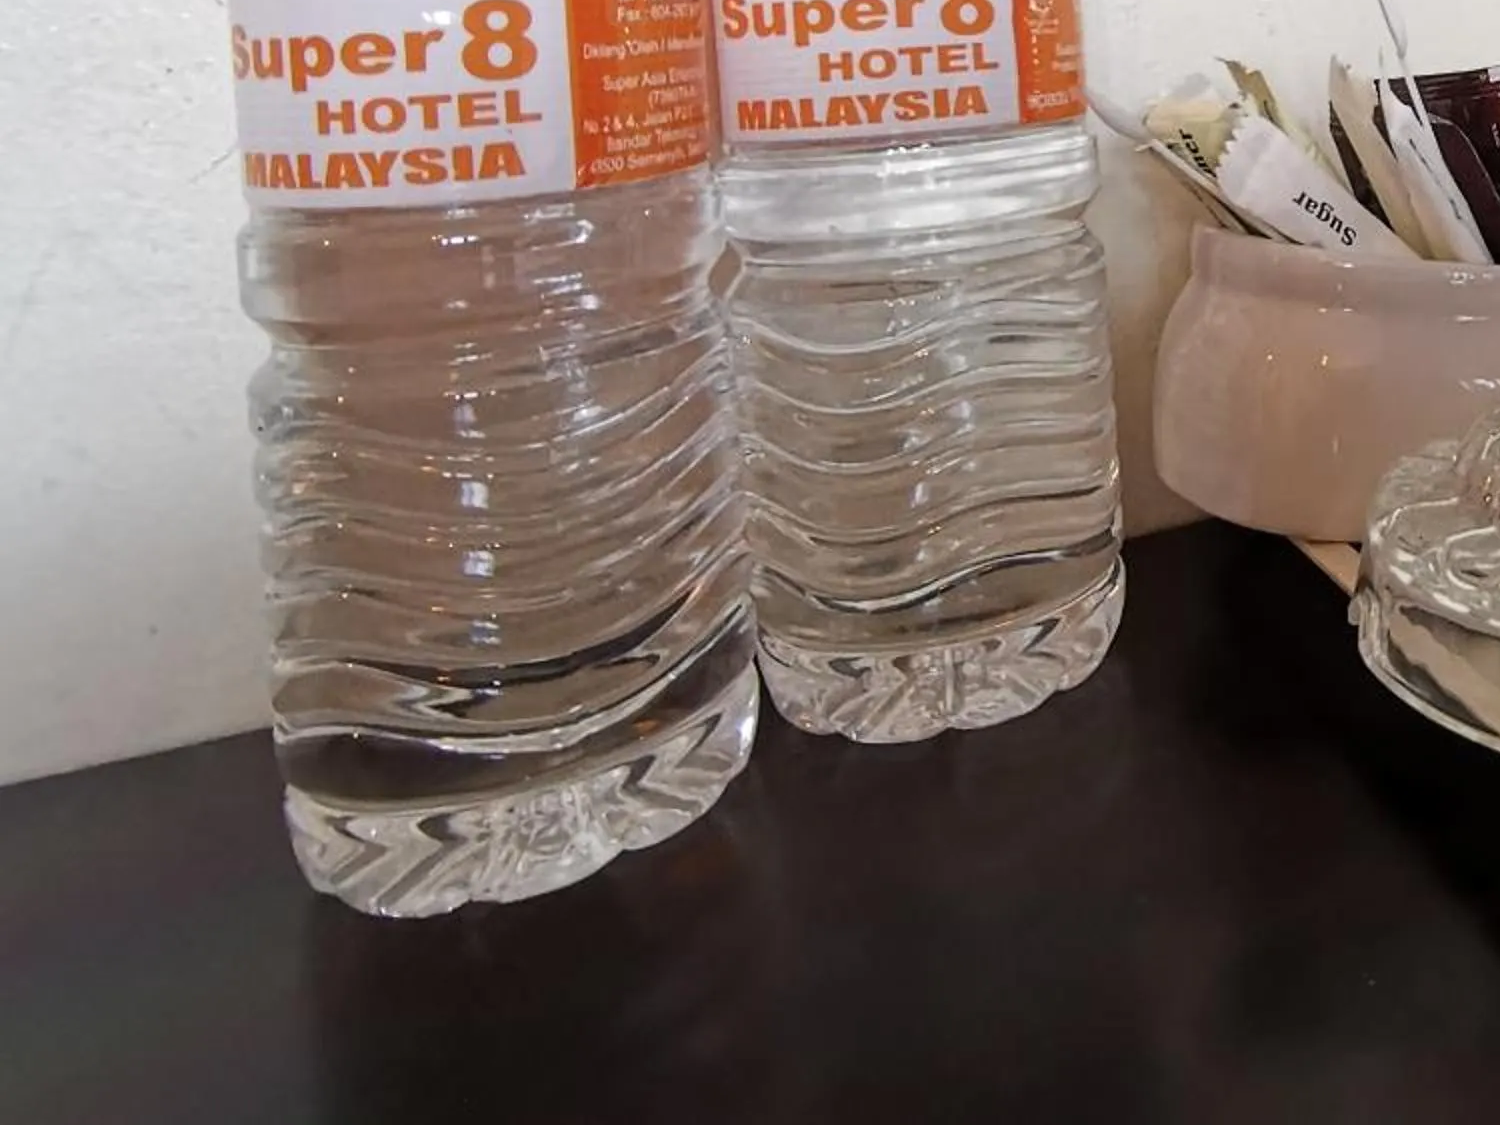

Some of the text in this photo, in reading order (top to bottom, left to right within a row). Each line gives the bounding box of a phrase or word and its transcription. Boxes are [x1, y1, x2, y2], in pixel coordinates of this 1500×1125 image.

[232, 22, 445, 93] Super
[818, 42, 1000, 83] HOTEL
[316, 88, 543, 136] HOTEL
[737, 85, 990, 131] MALAYSIA
[243, 141, 528, 191] MALAYSIA
[1292, 190, 1357, 246] Sugar
